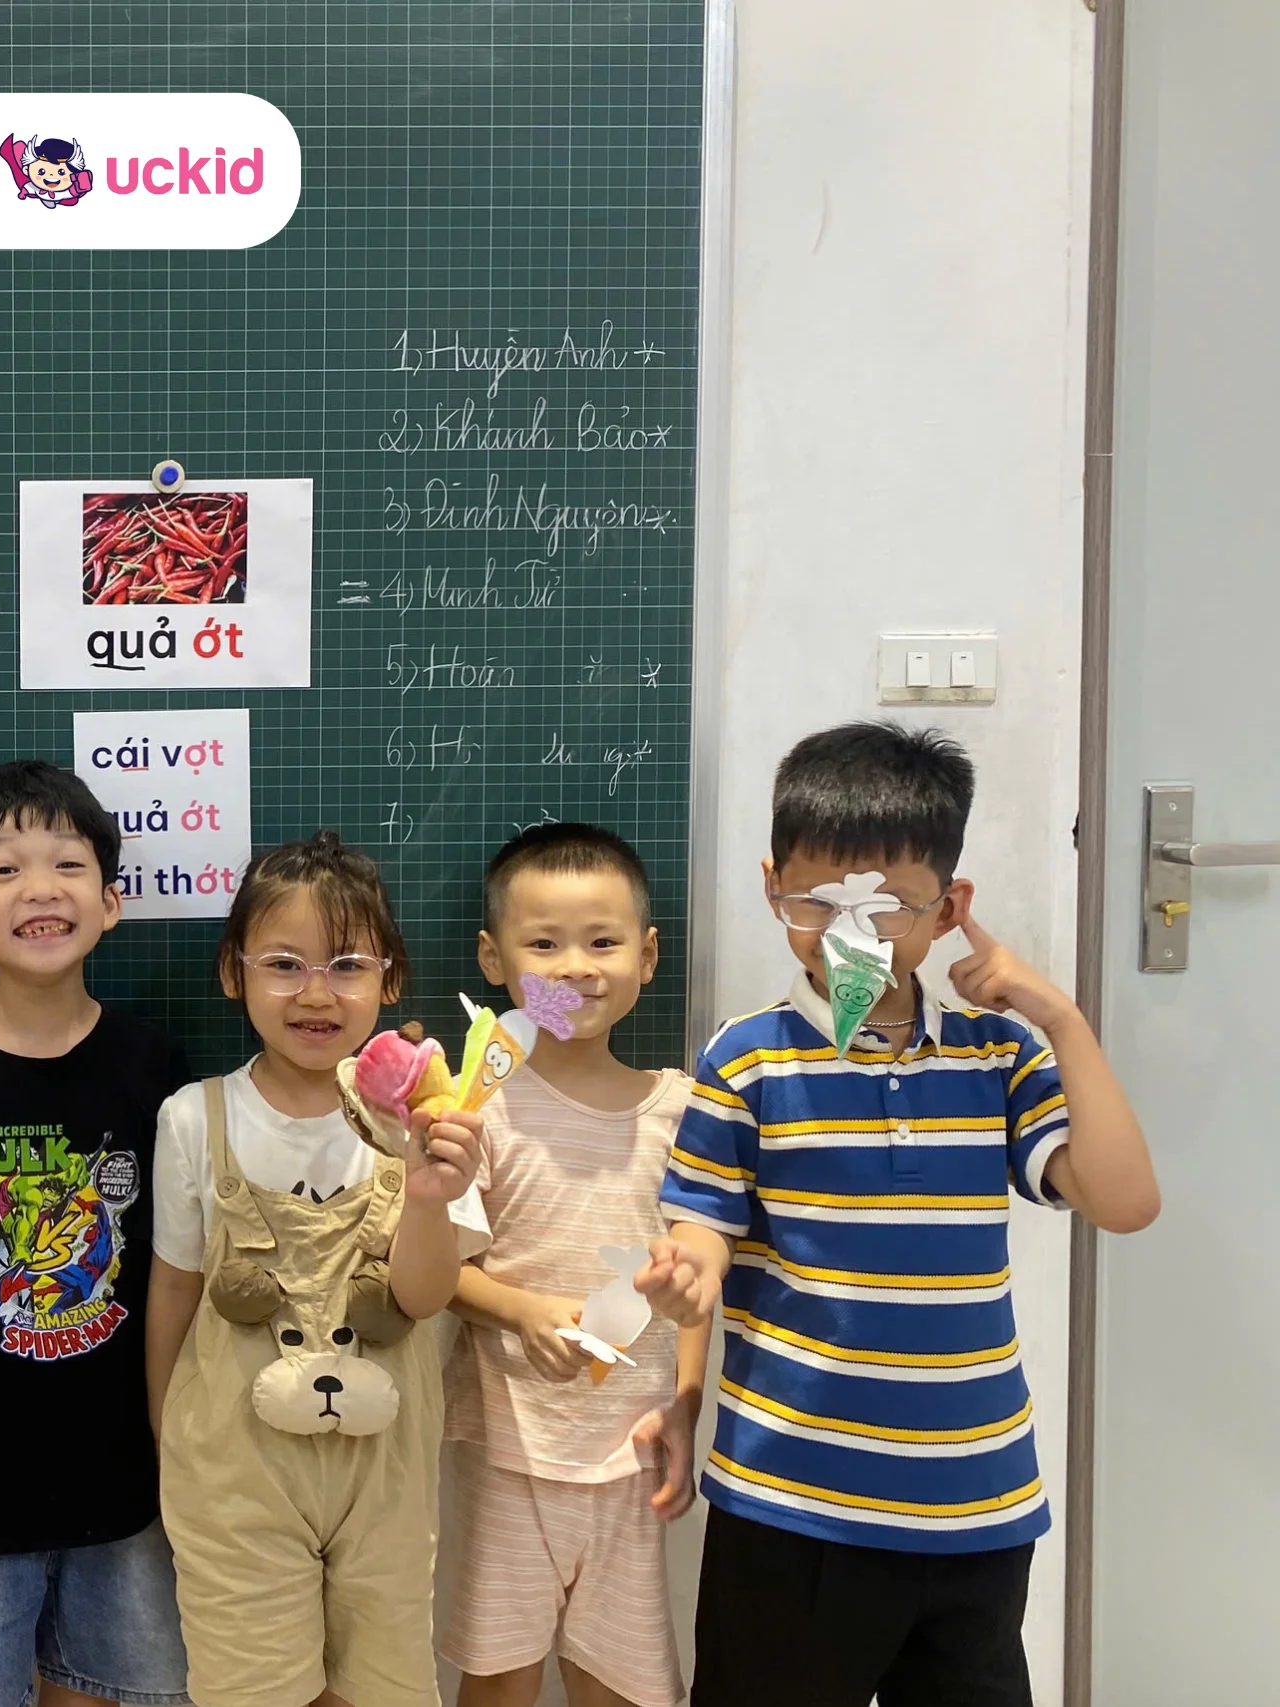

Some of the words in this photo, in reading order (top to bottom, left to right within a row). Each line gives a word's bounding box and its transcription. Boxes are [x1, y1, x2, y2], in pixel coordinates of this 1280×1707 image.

[555, 320, 627, 370] Anh
[435, 397, 555, 452] Khánh
[577, 400, 648, 452] Bảo
[423, 557, 503, 609] Minh
[87, 616, 177, 667] quả
[192, 617, 244, 659] ớt
[91, 736, 150, 769] cái
[161, 739, 225, 775] vợt
[180, 800, 221, 832] ớt
[114, 865, 143, 896] ái
[154, 863, 235, 895] thớt
[33, 1298, 107, 1329] AMAZING
